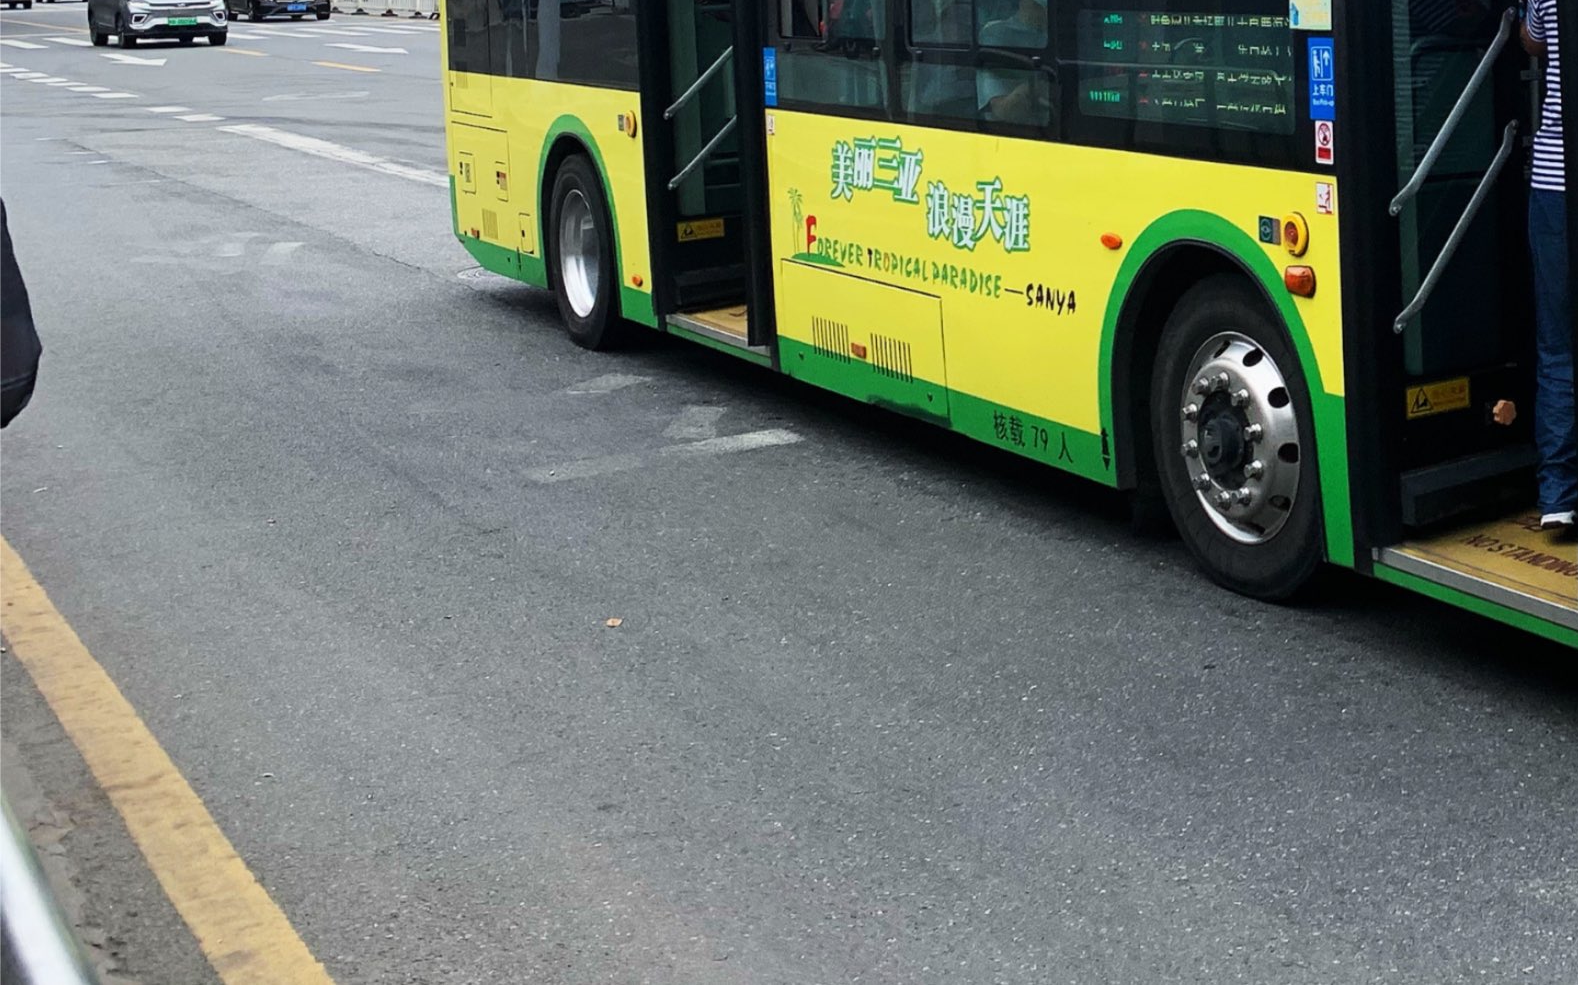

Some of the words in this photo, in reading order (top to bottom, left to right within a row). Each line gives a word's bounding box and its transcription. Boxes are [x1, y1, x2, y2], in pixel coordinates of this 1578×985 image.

[831, 135, 924, 204] 美丽三亚
[926, 175, 1030, 253] 浪漫天涯
[867, 248, 929, 282] TROPICAL
[931, 260, 1002, 299] PARADISE
[993, 409, 1026, 448] 核载
[1030, 424, 1049, 452] 79
[1058, 431, 1074, 464] 人
